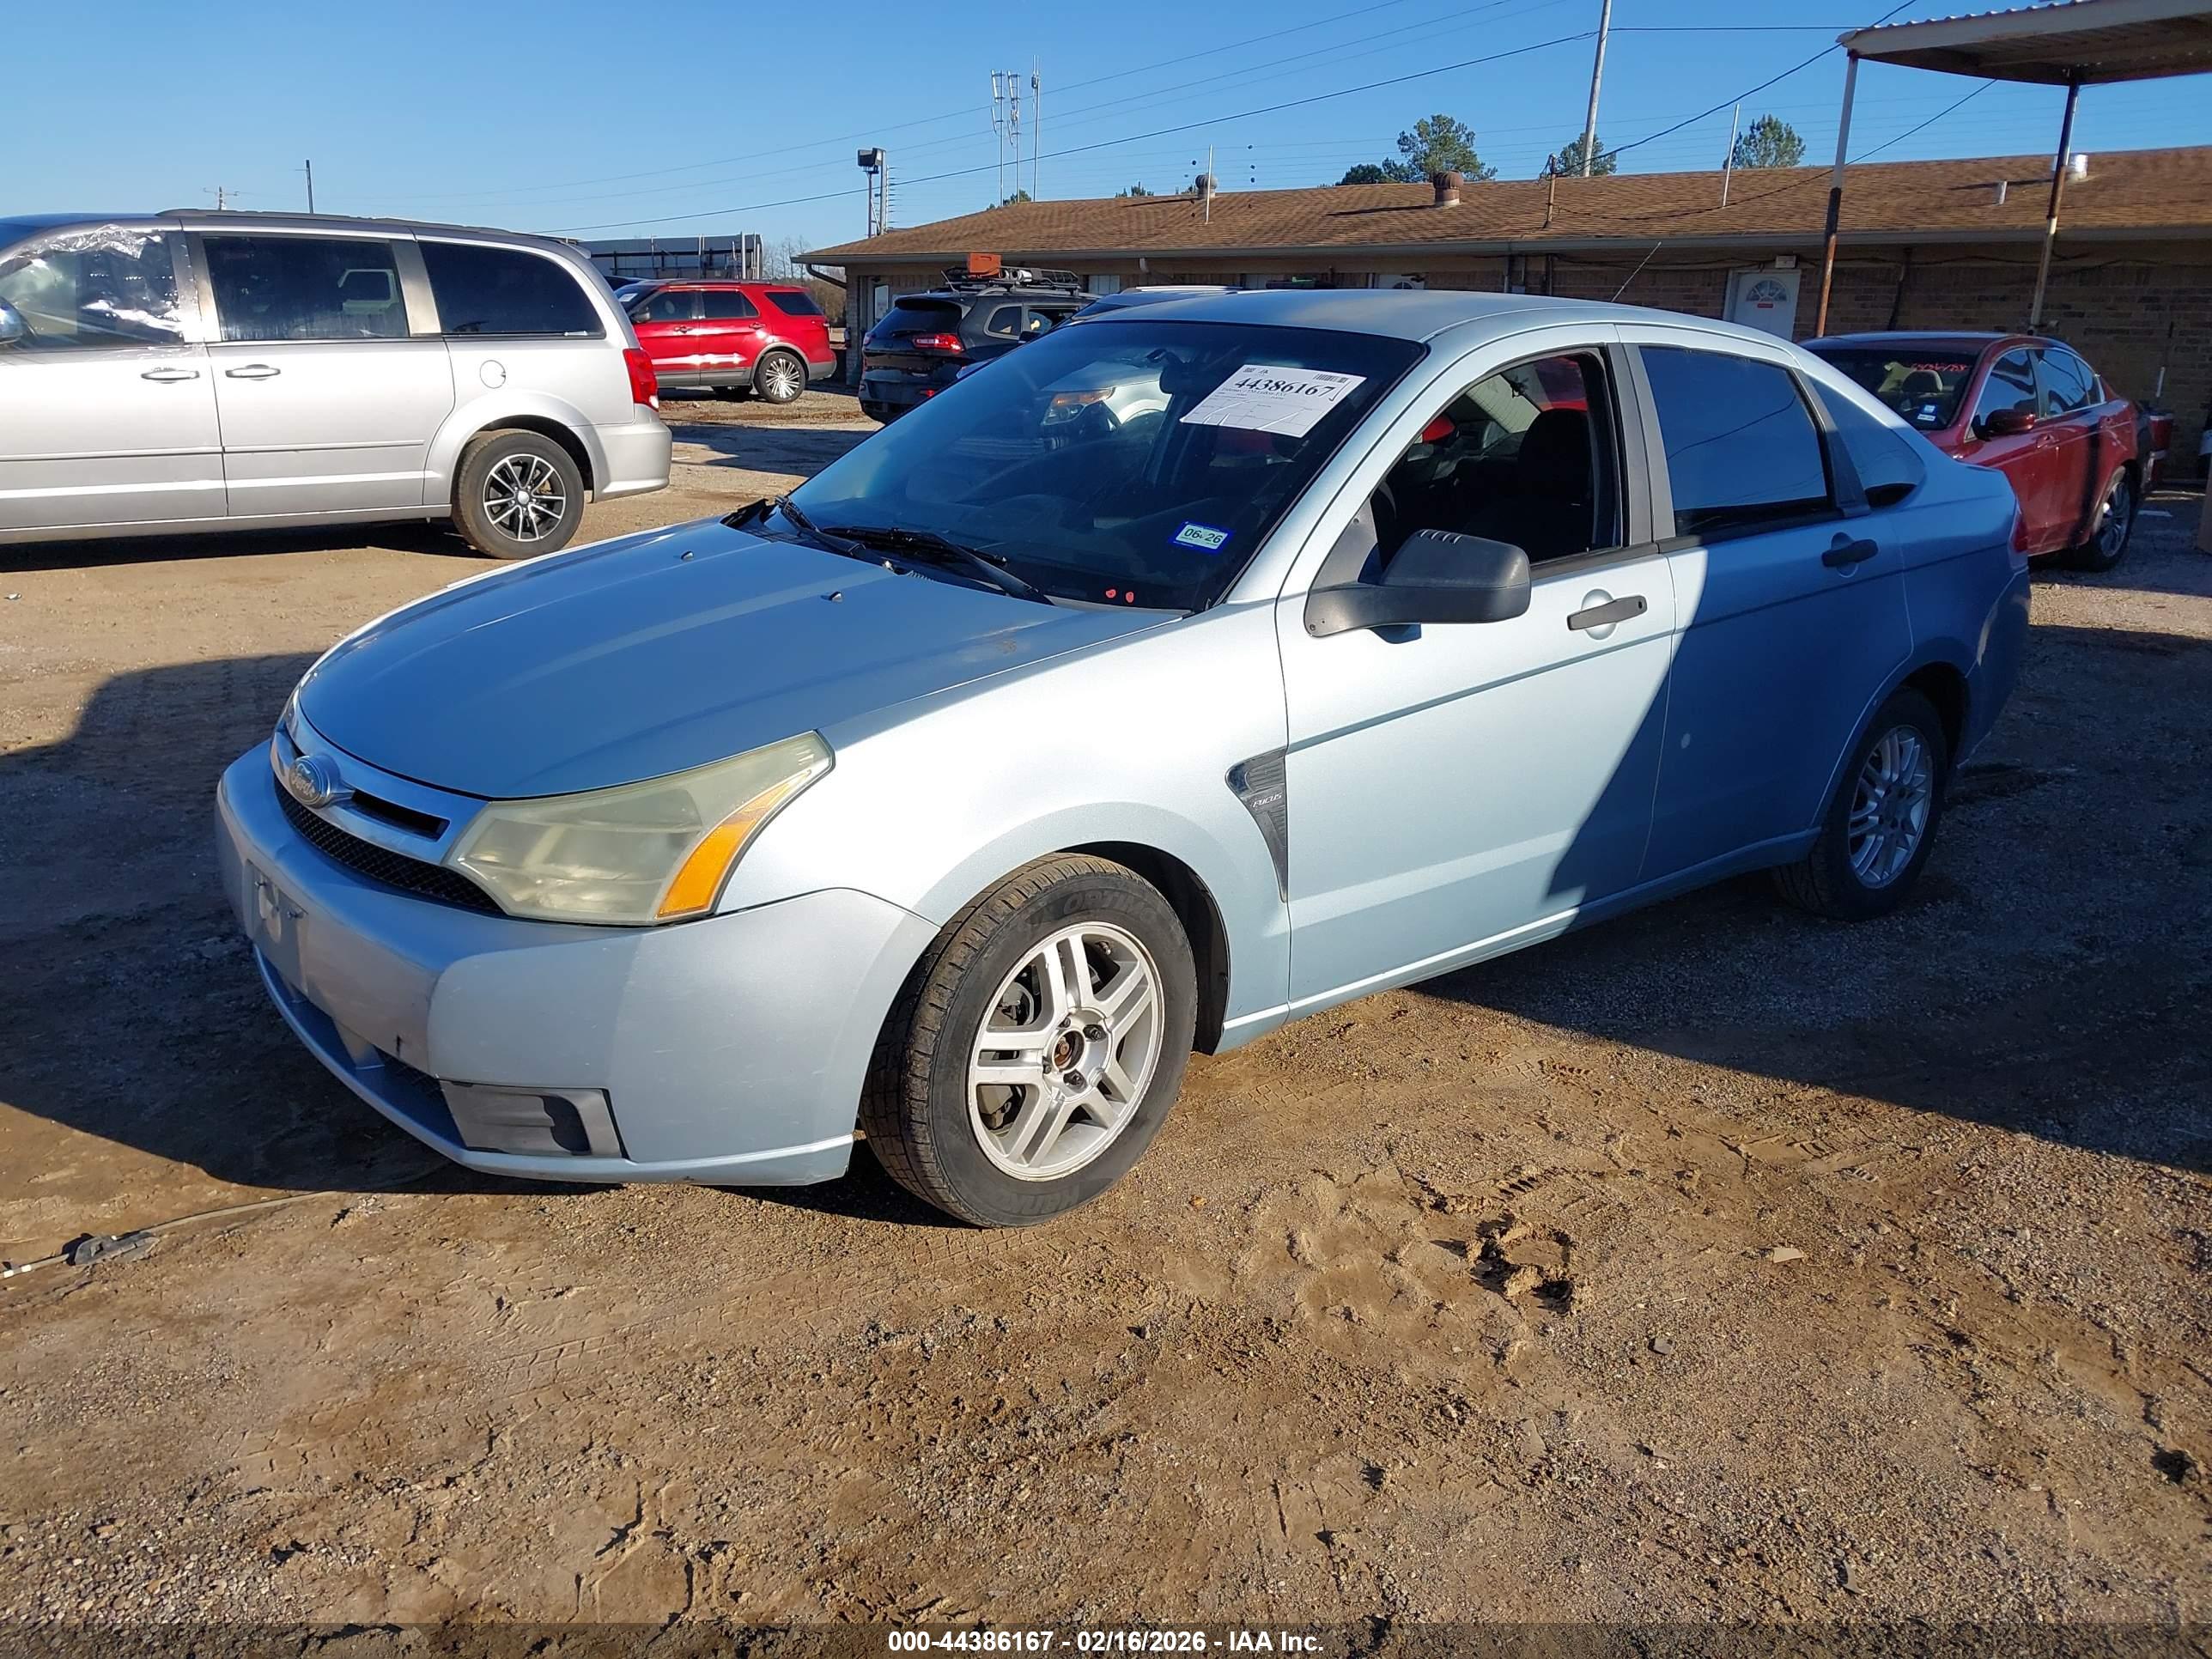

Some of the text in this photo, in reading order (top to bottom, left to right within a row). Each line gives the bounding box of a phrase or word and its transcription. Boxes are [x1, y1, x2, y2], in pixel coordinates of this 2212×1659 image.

[1234, 377, 1334, 398] 44386167
[290, 763, 316, 797] Ford
[1252, 793, 1282, 808] FOCUS
